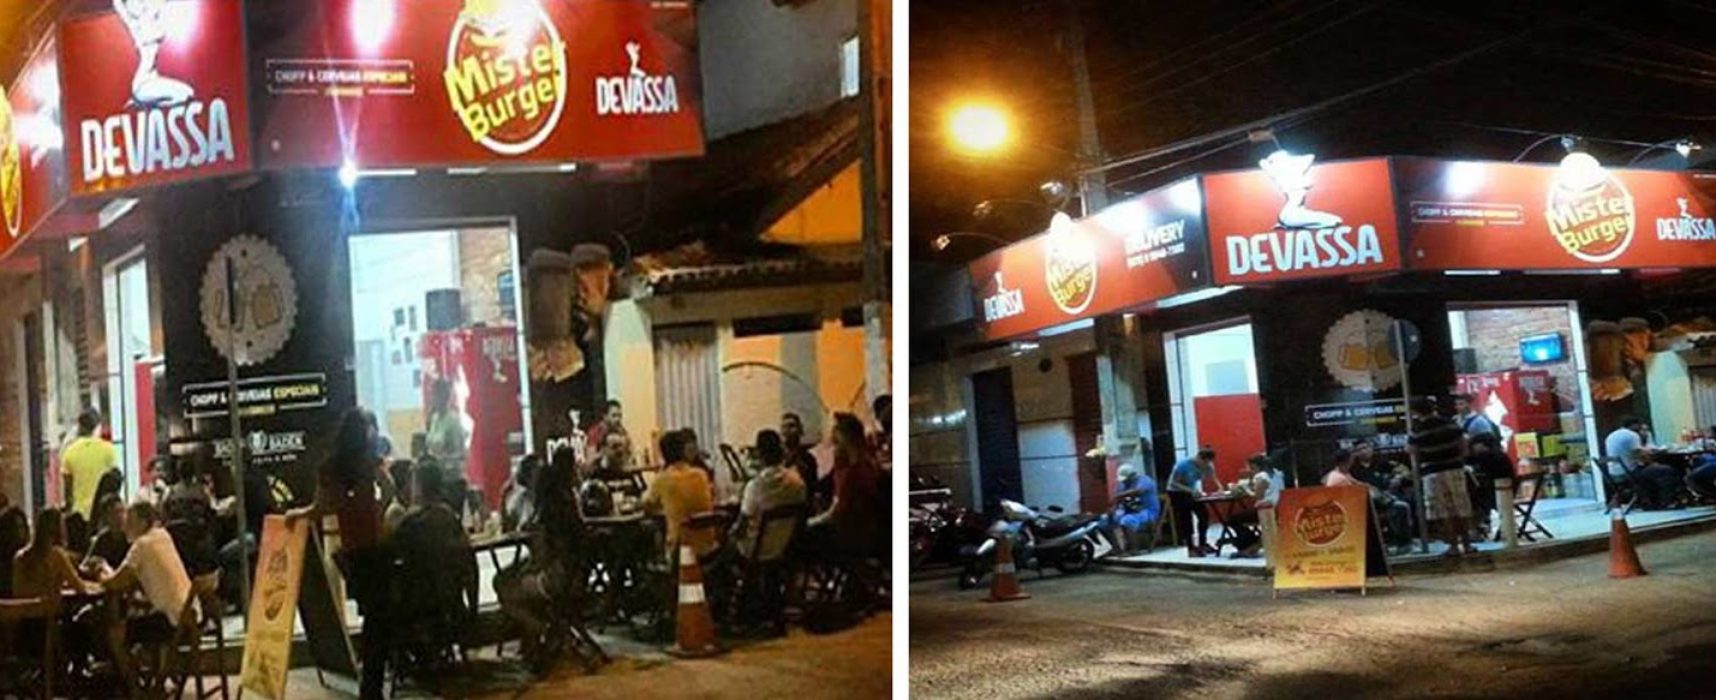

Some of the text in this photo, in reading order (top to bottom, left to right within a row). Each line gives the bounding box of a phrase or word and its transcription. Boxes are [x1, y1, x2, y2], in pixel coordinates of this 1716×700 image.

[464, 73, 562, 142] Burger
[596, 76, 679, 115] DEVASSA
[81, 98, 234, 182] DEVASSA
[1226, 224, 1383, 276] DEVASSA
[1561, 215, 1634, 254] Burger
[1656, 217, 1716, 241] DEVASSA
